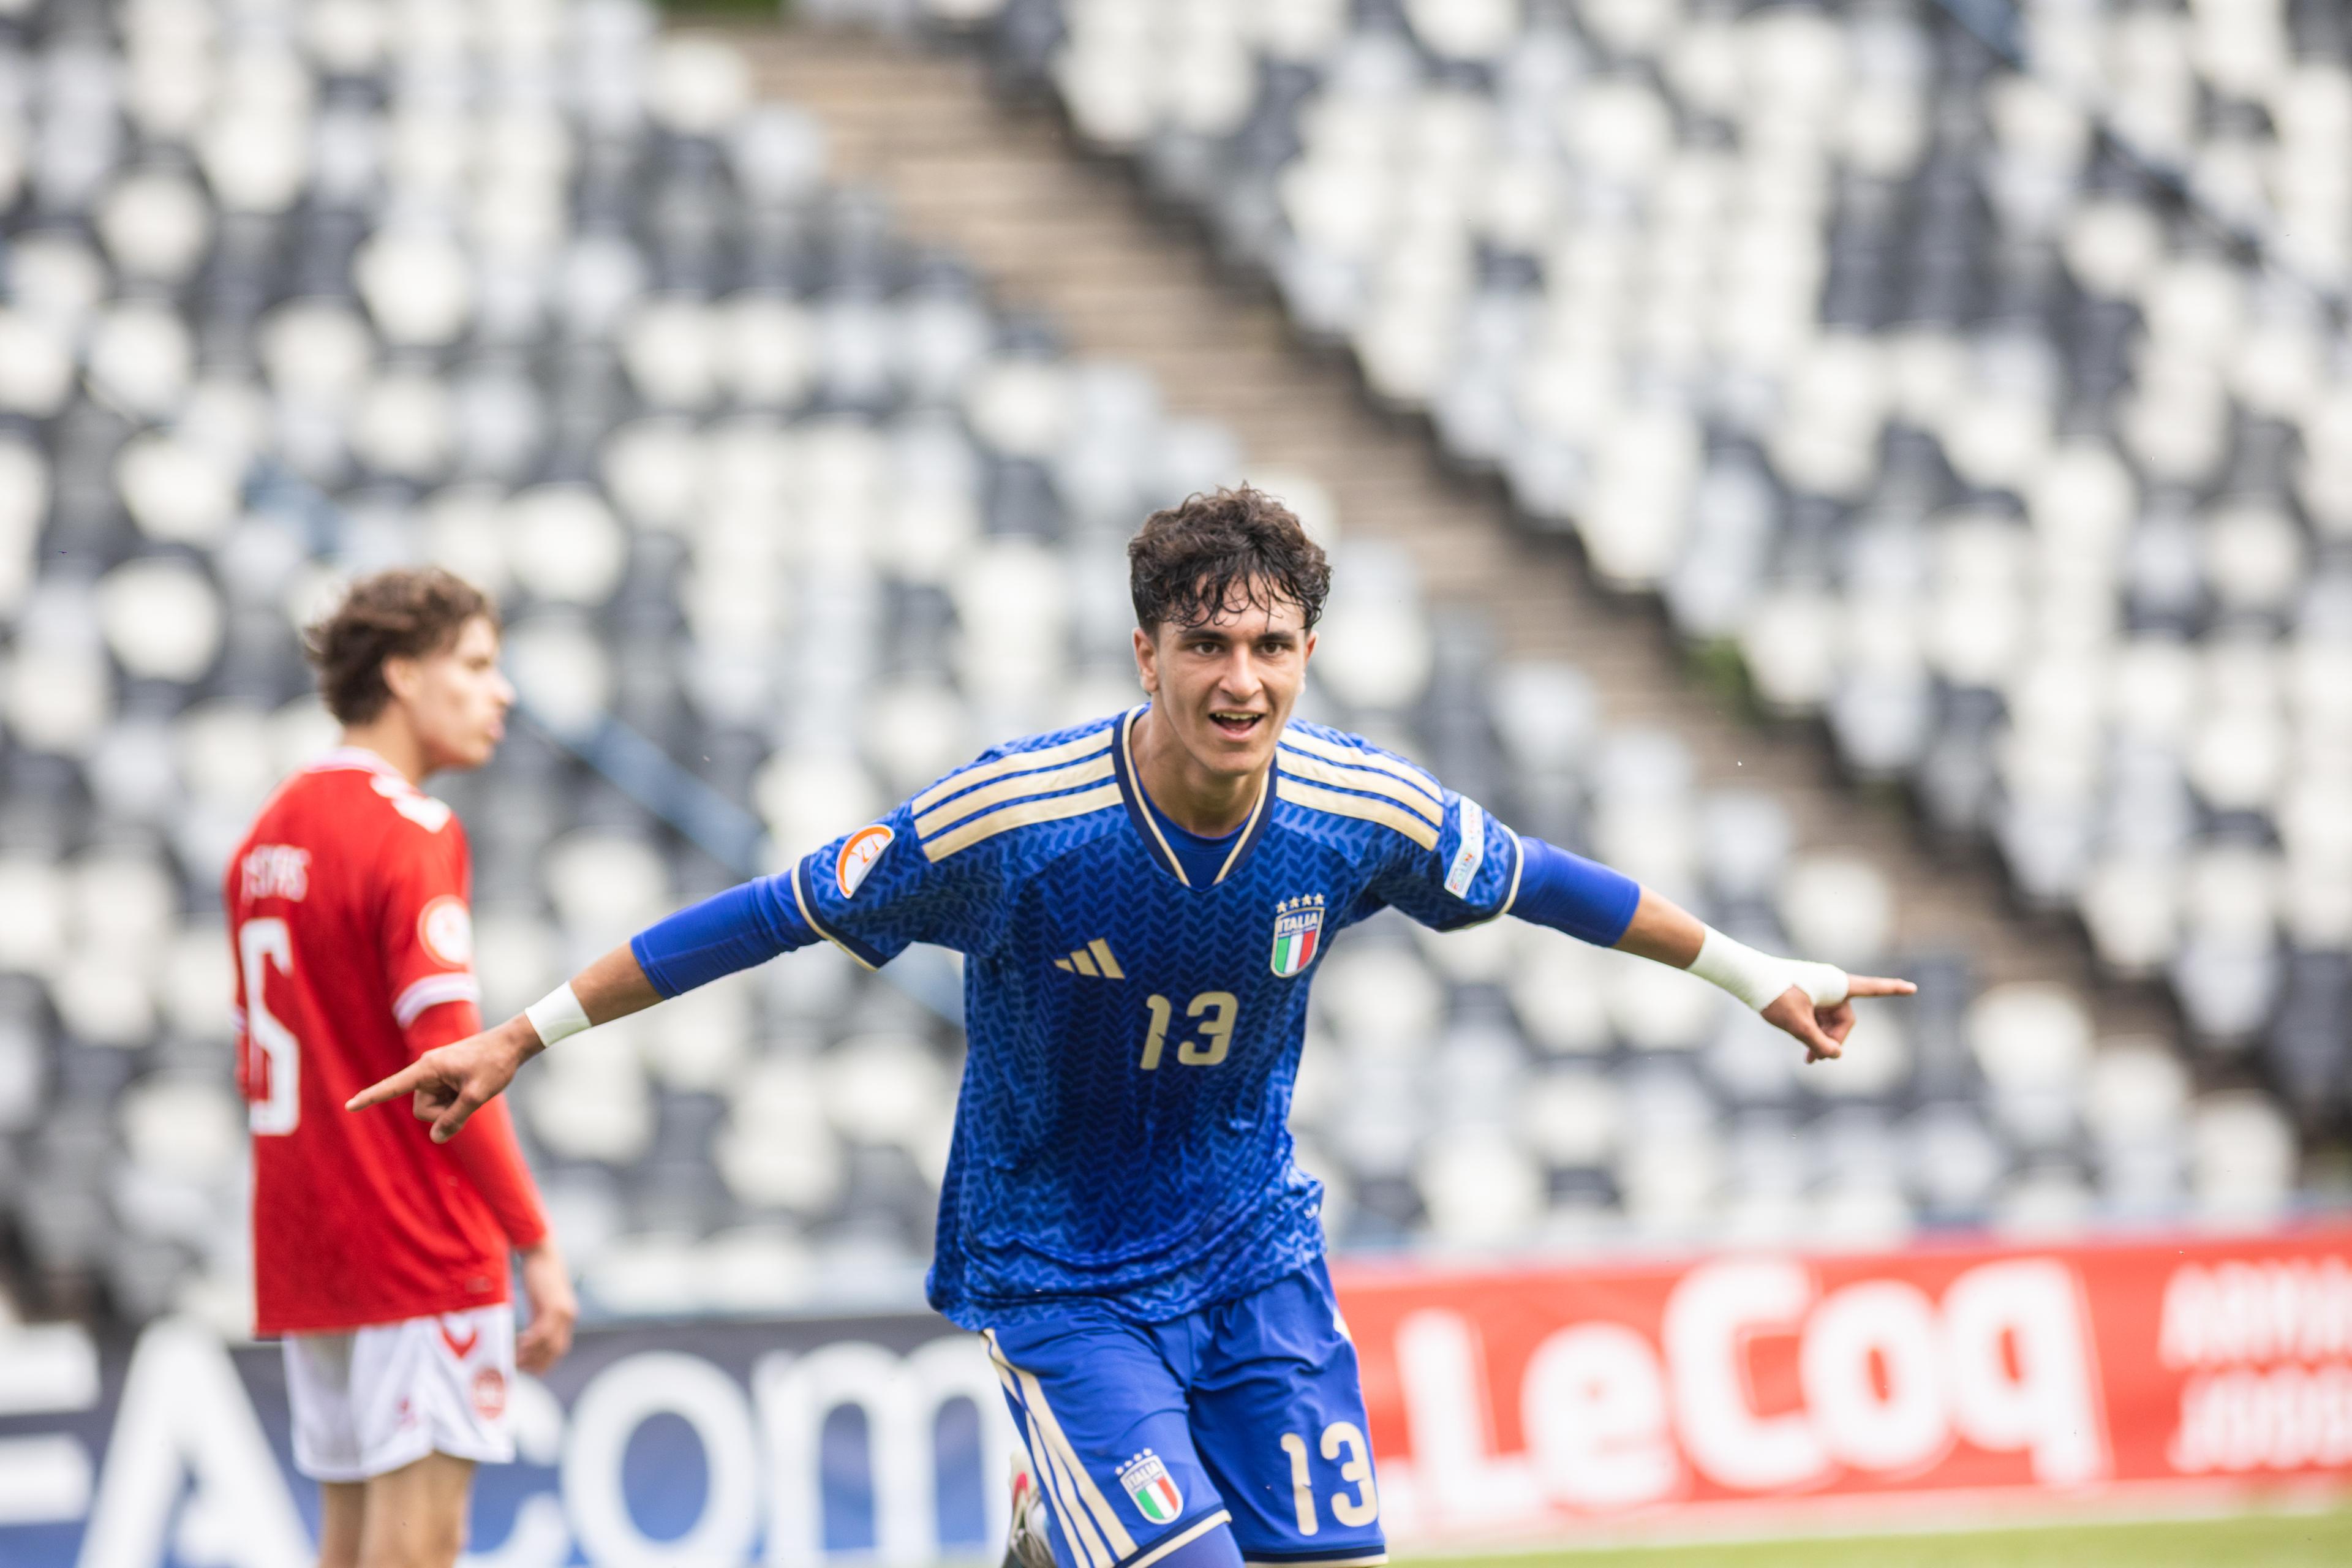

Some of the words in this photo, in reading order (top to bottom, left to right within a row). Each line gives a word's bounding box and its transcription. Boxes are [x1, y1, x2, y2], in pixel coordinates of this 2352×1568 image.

[1278, 912, 1318, 932] ITALIA
[1140, 990, 1239, 1071] 13
[1280, 1421, 1379, 1536] 13
